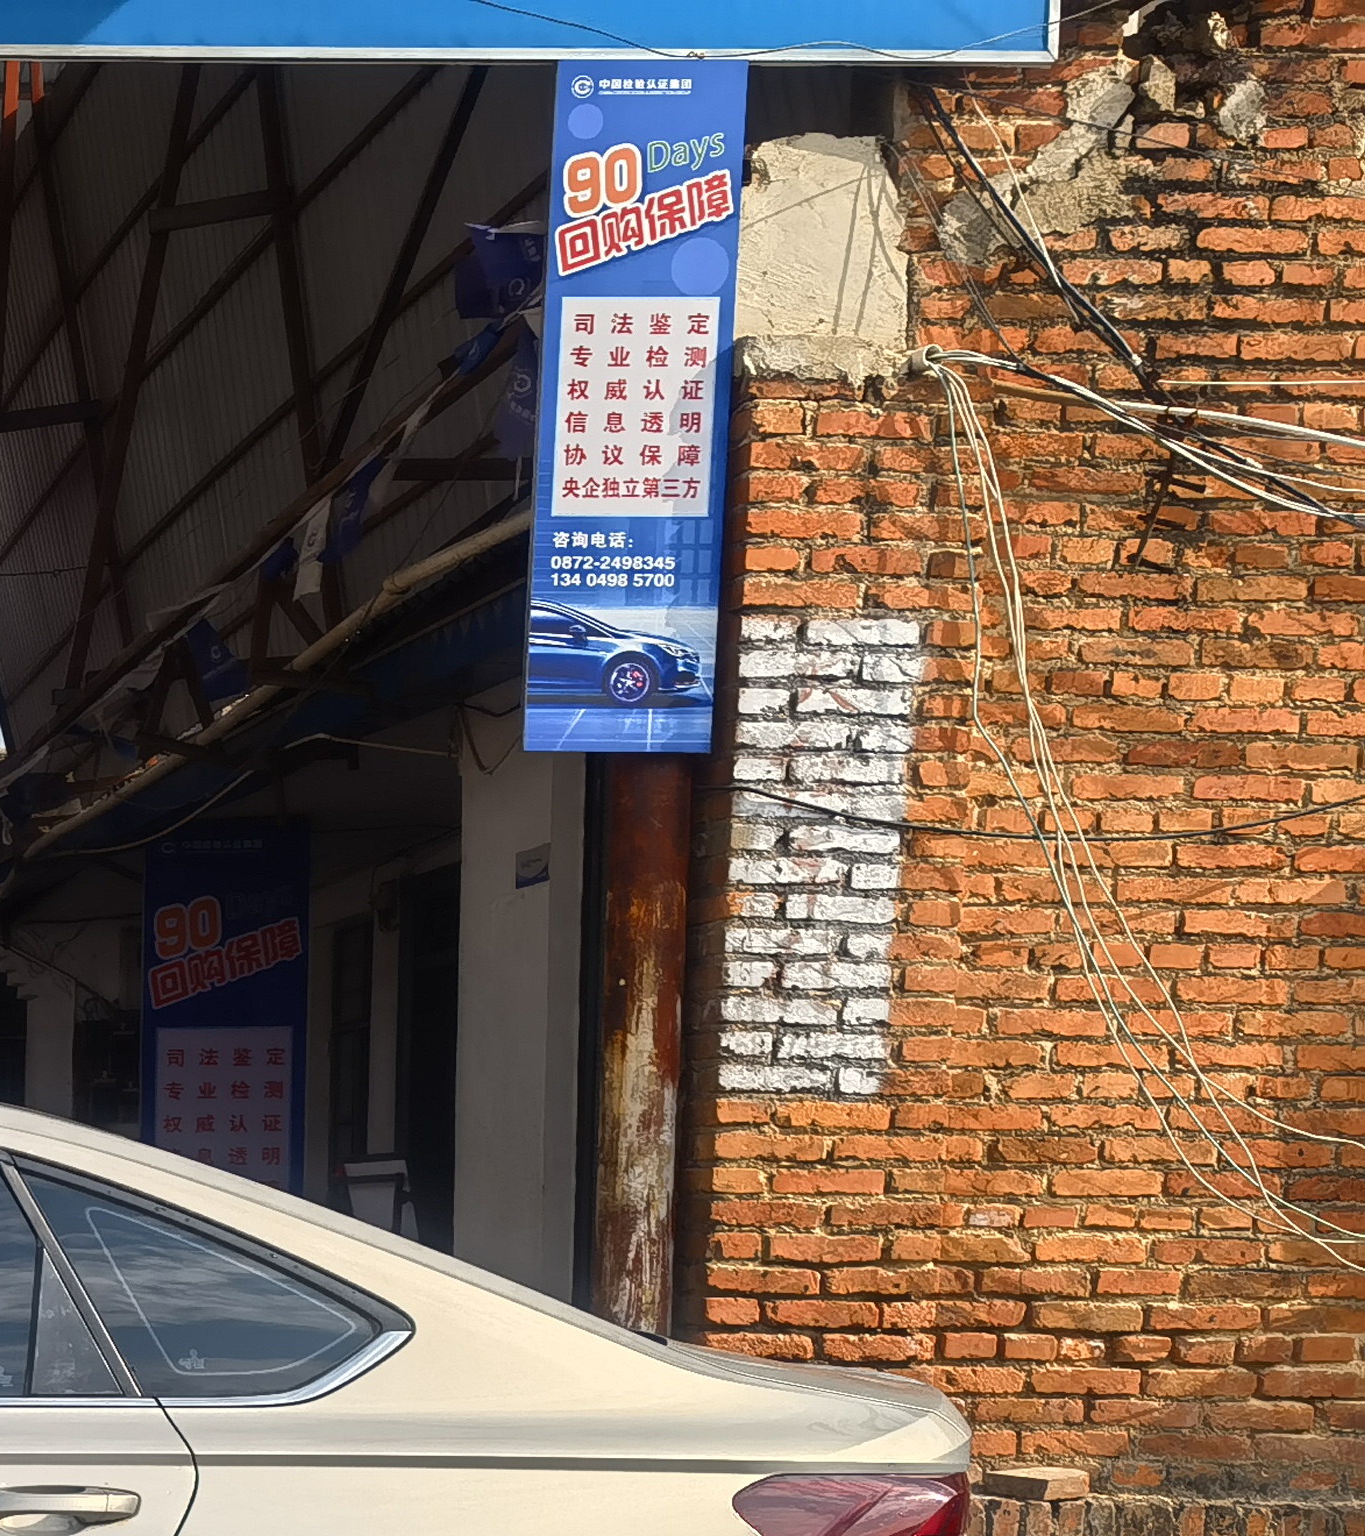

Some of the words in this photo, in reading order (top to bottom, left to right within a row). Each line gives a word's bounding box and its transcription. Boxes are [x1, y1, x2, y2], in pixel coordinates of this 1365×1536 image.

[563, 143, 643, 218] 90
[647, 132, 725, 173] Days
[555, 169, 734, 277] 回购保障
[574, 313, 710, 335] 司法鉴定
[570, 345, 708, 368] 专业检测
[567, 379, 704, 401] 权威认证
[565, 411, 701, 434] 信息透明
[564, 444, 701, 467] 协议保障
[562, 477, 701, 499] 央企独立第三方
[550, 556, 676, 570] 0872-2498345
[551, 573, 581, 587] 134
[586, 574, 628, 587] 0498
[633, 574, 675, 587] 5700
[154, 895, 222, 959] 90
[149, 916, 303, 1010] 回购保障
[166, 1048, 285, 1067] 司法鉴定
[163, 1081, 284, 1101] 专业检测
[163, 1114, 282, 1134] 权威认证
